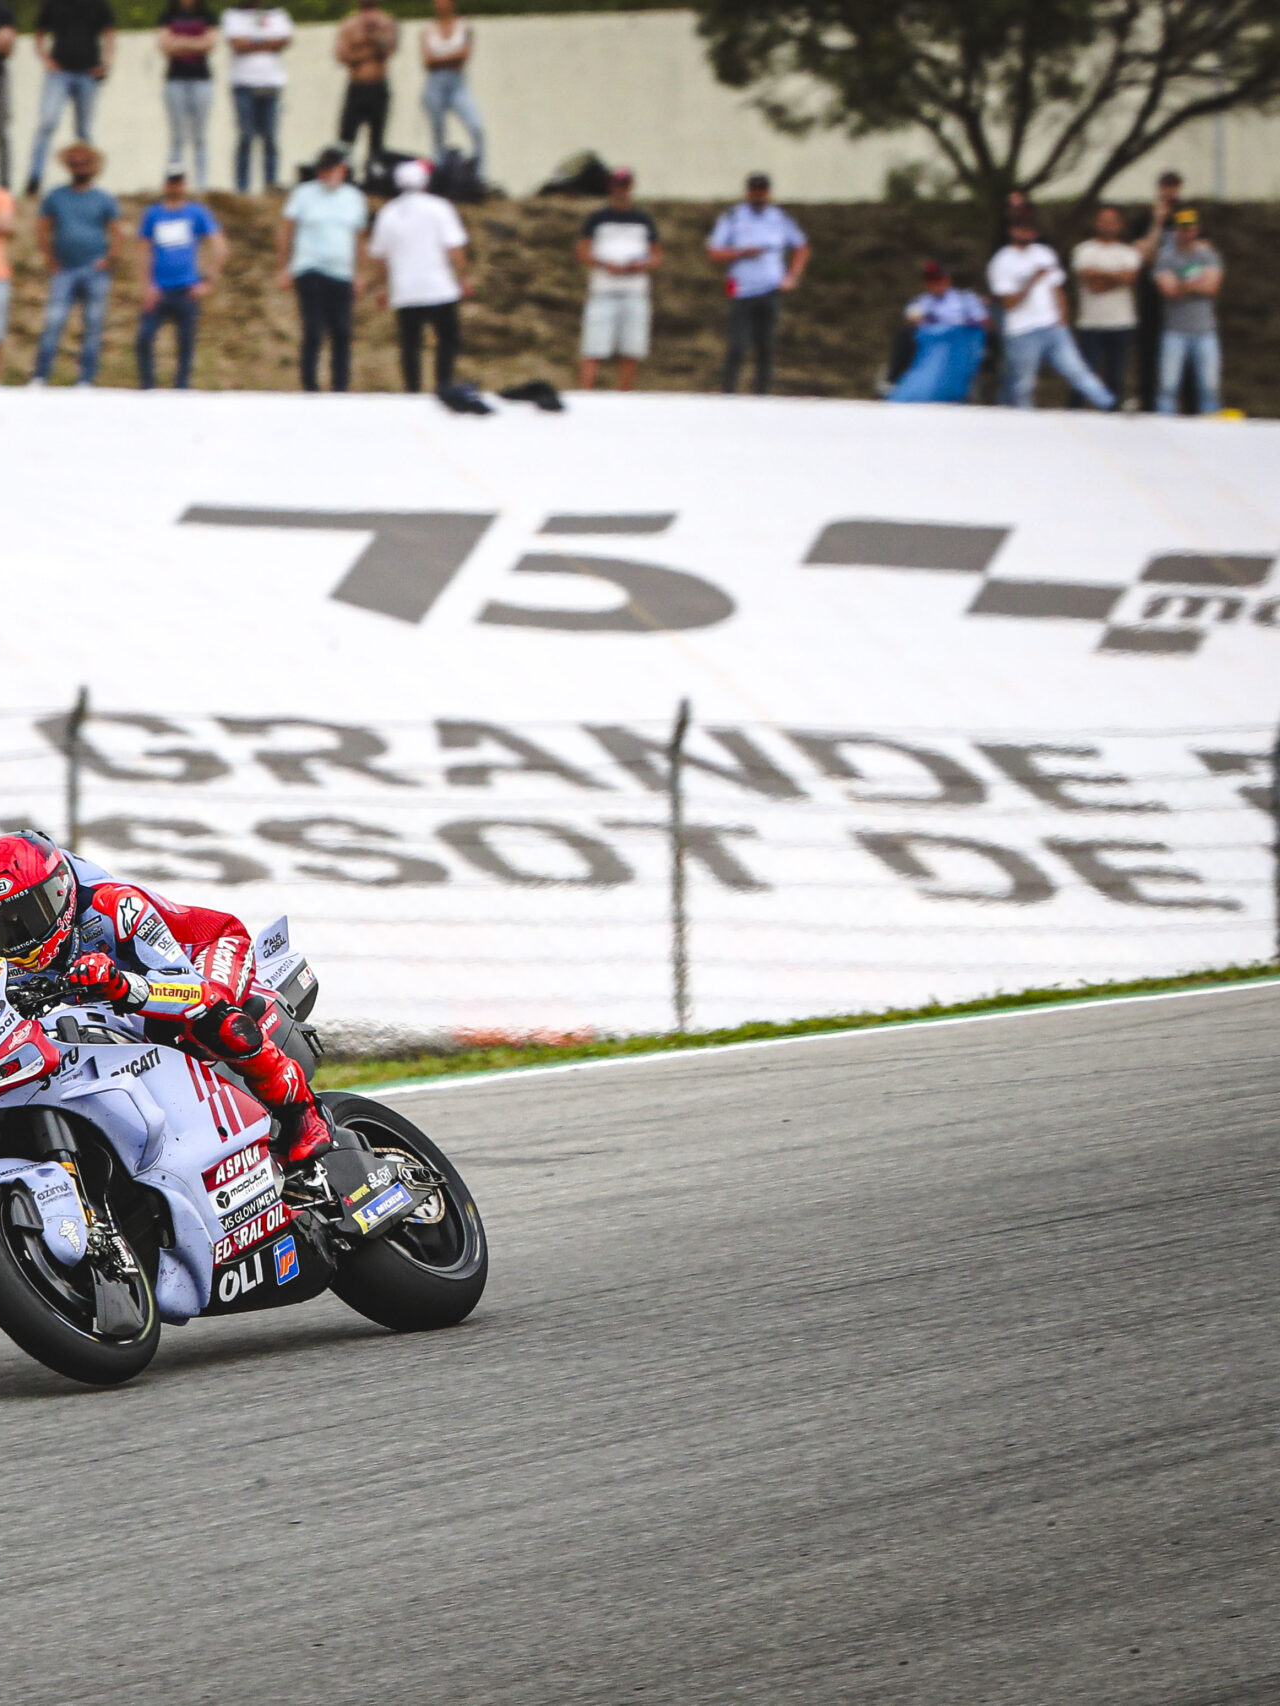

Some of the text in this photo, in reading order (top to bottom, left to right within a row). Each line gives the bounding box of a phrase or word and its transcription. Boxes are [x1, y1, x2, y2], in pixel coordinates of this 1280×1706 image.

[176, 503, 738, 632] 75
[34, 708, 1172, 812] GRANDE
[848, 828, 1244, 912] DE
[5, 889, 30, 904] WINGS
[137, 918, 155, 937] BOLD
[9, 937, 37, 952] VERTICAL
[262, 938, 288, 960] GLOBAL
[8, 967, 27, 978] HOEI
[148, 982, 201, 1001] Antangin
[261, 1012, 279, 1033] AIKO
[110, 1047, 162, 1078] CATI
[215, 1143, 261, 1185] ASPIRA
[37, 1181, 73, 1201] azimut
[231, 1168, 267, 1198] MODULA
[280, 1250, 295, 1278] IP
